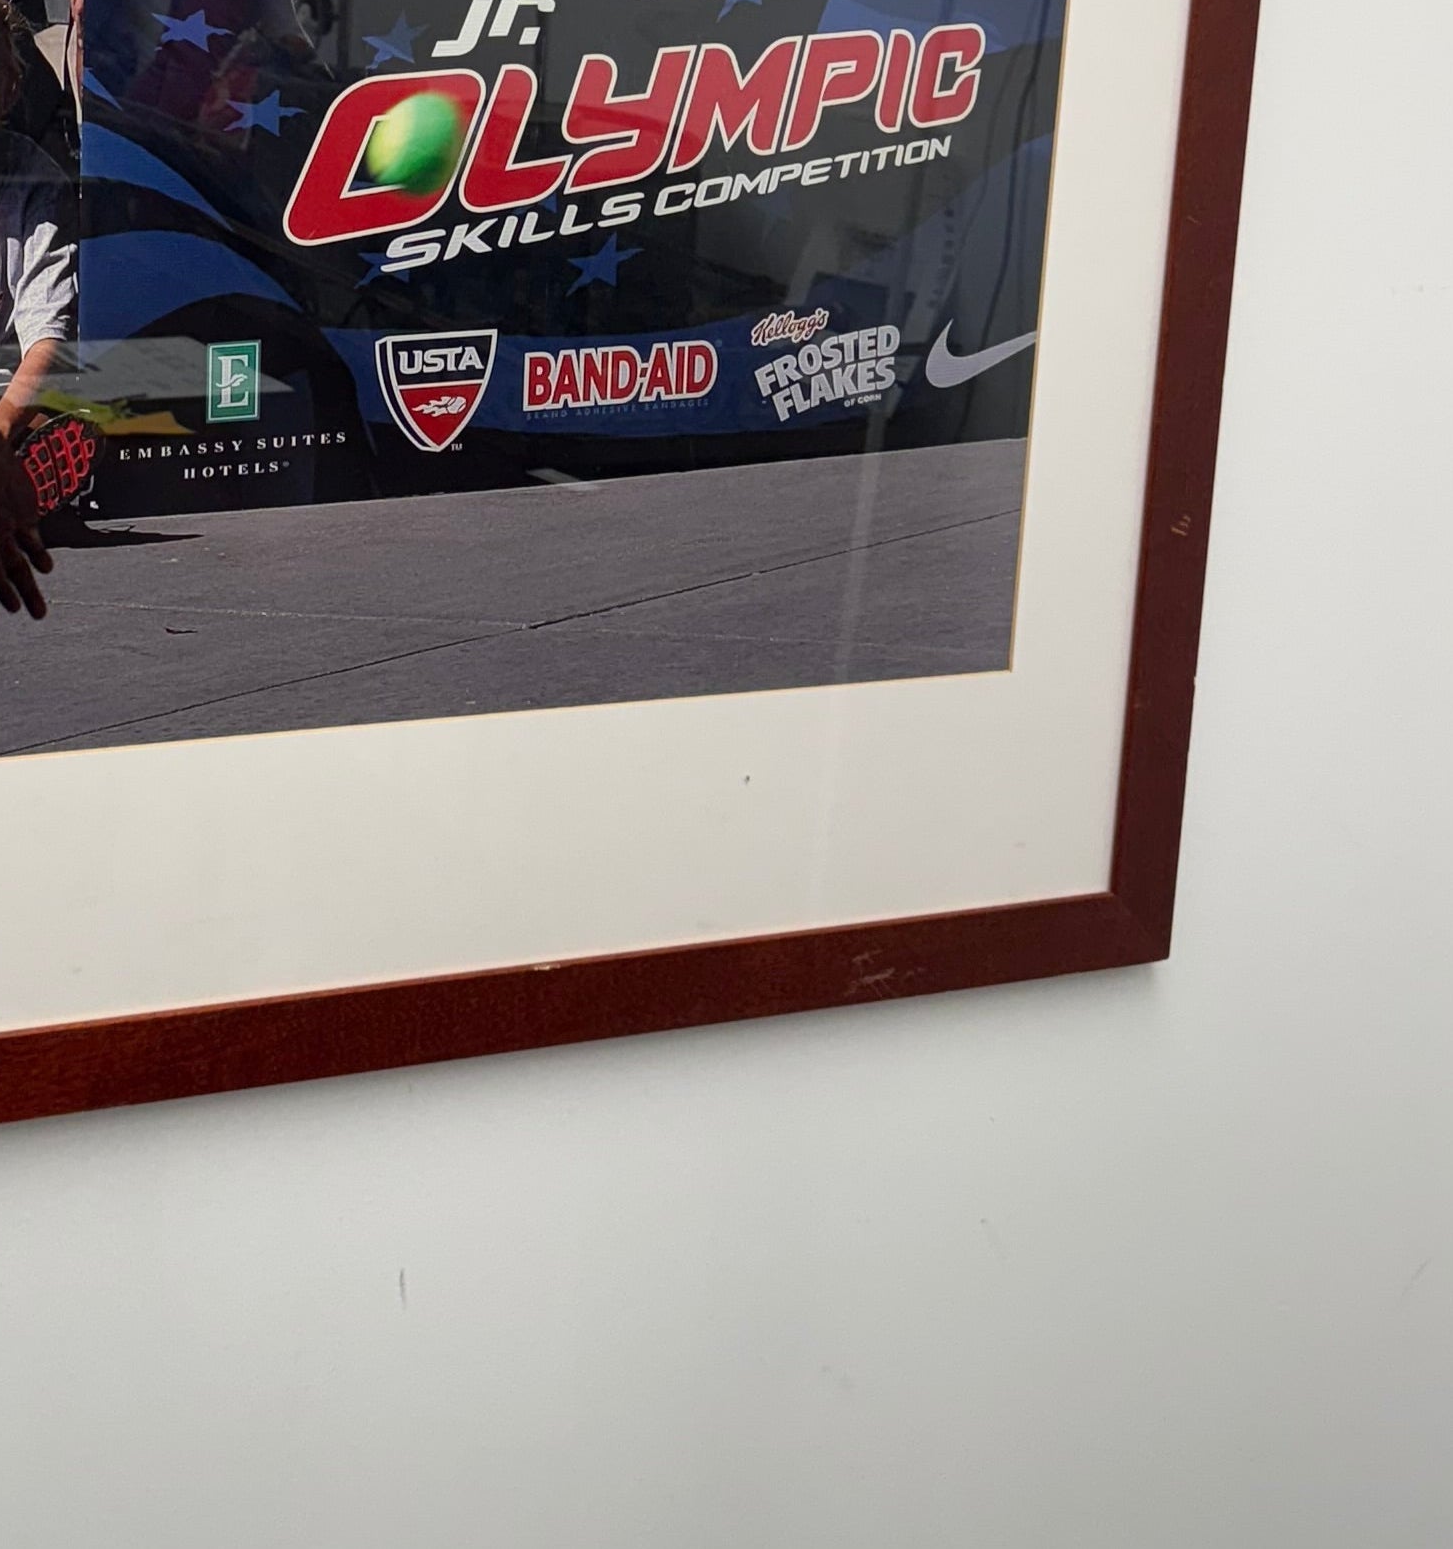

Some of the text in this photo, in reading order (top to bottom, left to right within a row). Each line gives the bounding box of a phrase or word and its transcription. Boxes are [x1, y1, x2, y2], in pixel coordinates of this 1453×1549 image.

[283, 23, 986, 247] OLYMPIC
[380, 135, 952, 273] SKILLS COMPETITION
[398, 346, 485, 375] USTA
[751, 307, 829, 346] Kellogg's
[754, 324, 900, 398] FROSTED
[523, 339, 718, 412] BAND-AID
[771, 356, 896, 422] FLAKES
[119, 431, 347, 461] EMBASSY SUITES
